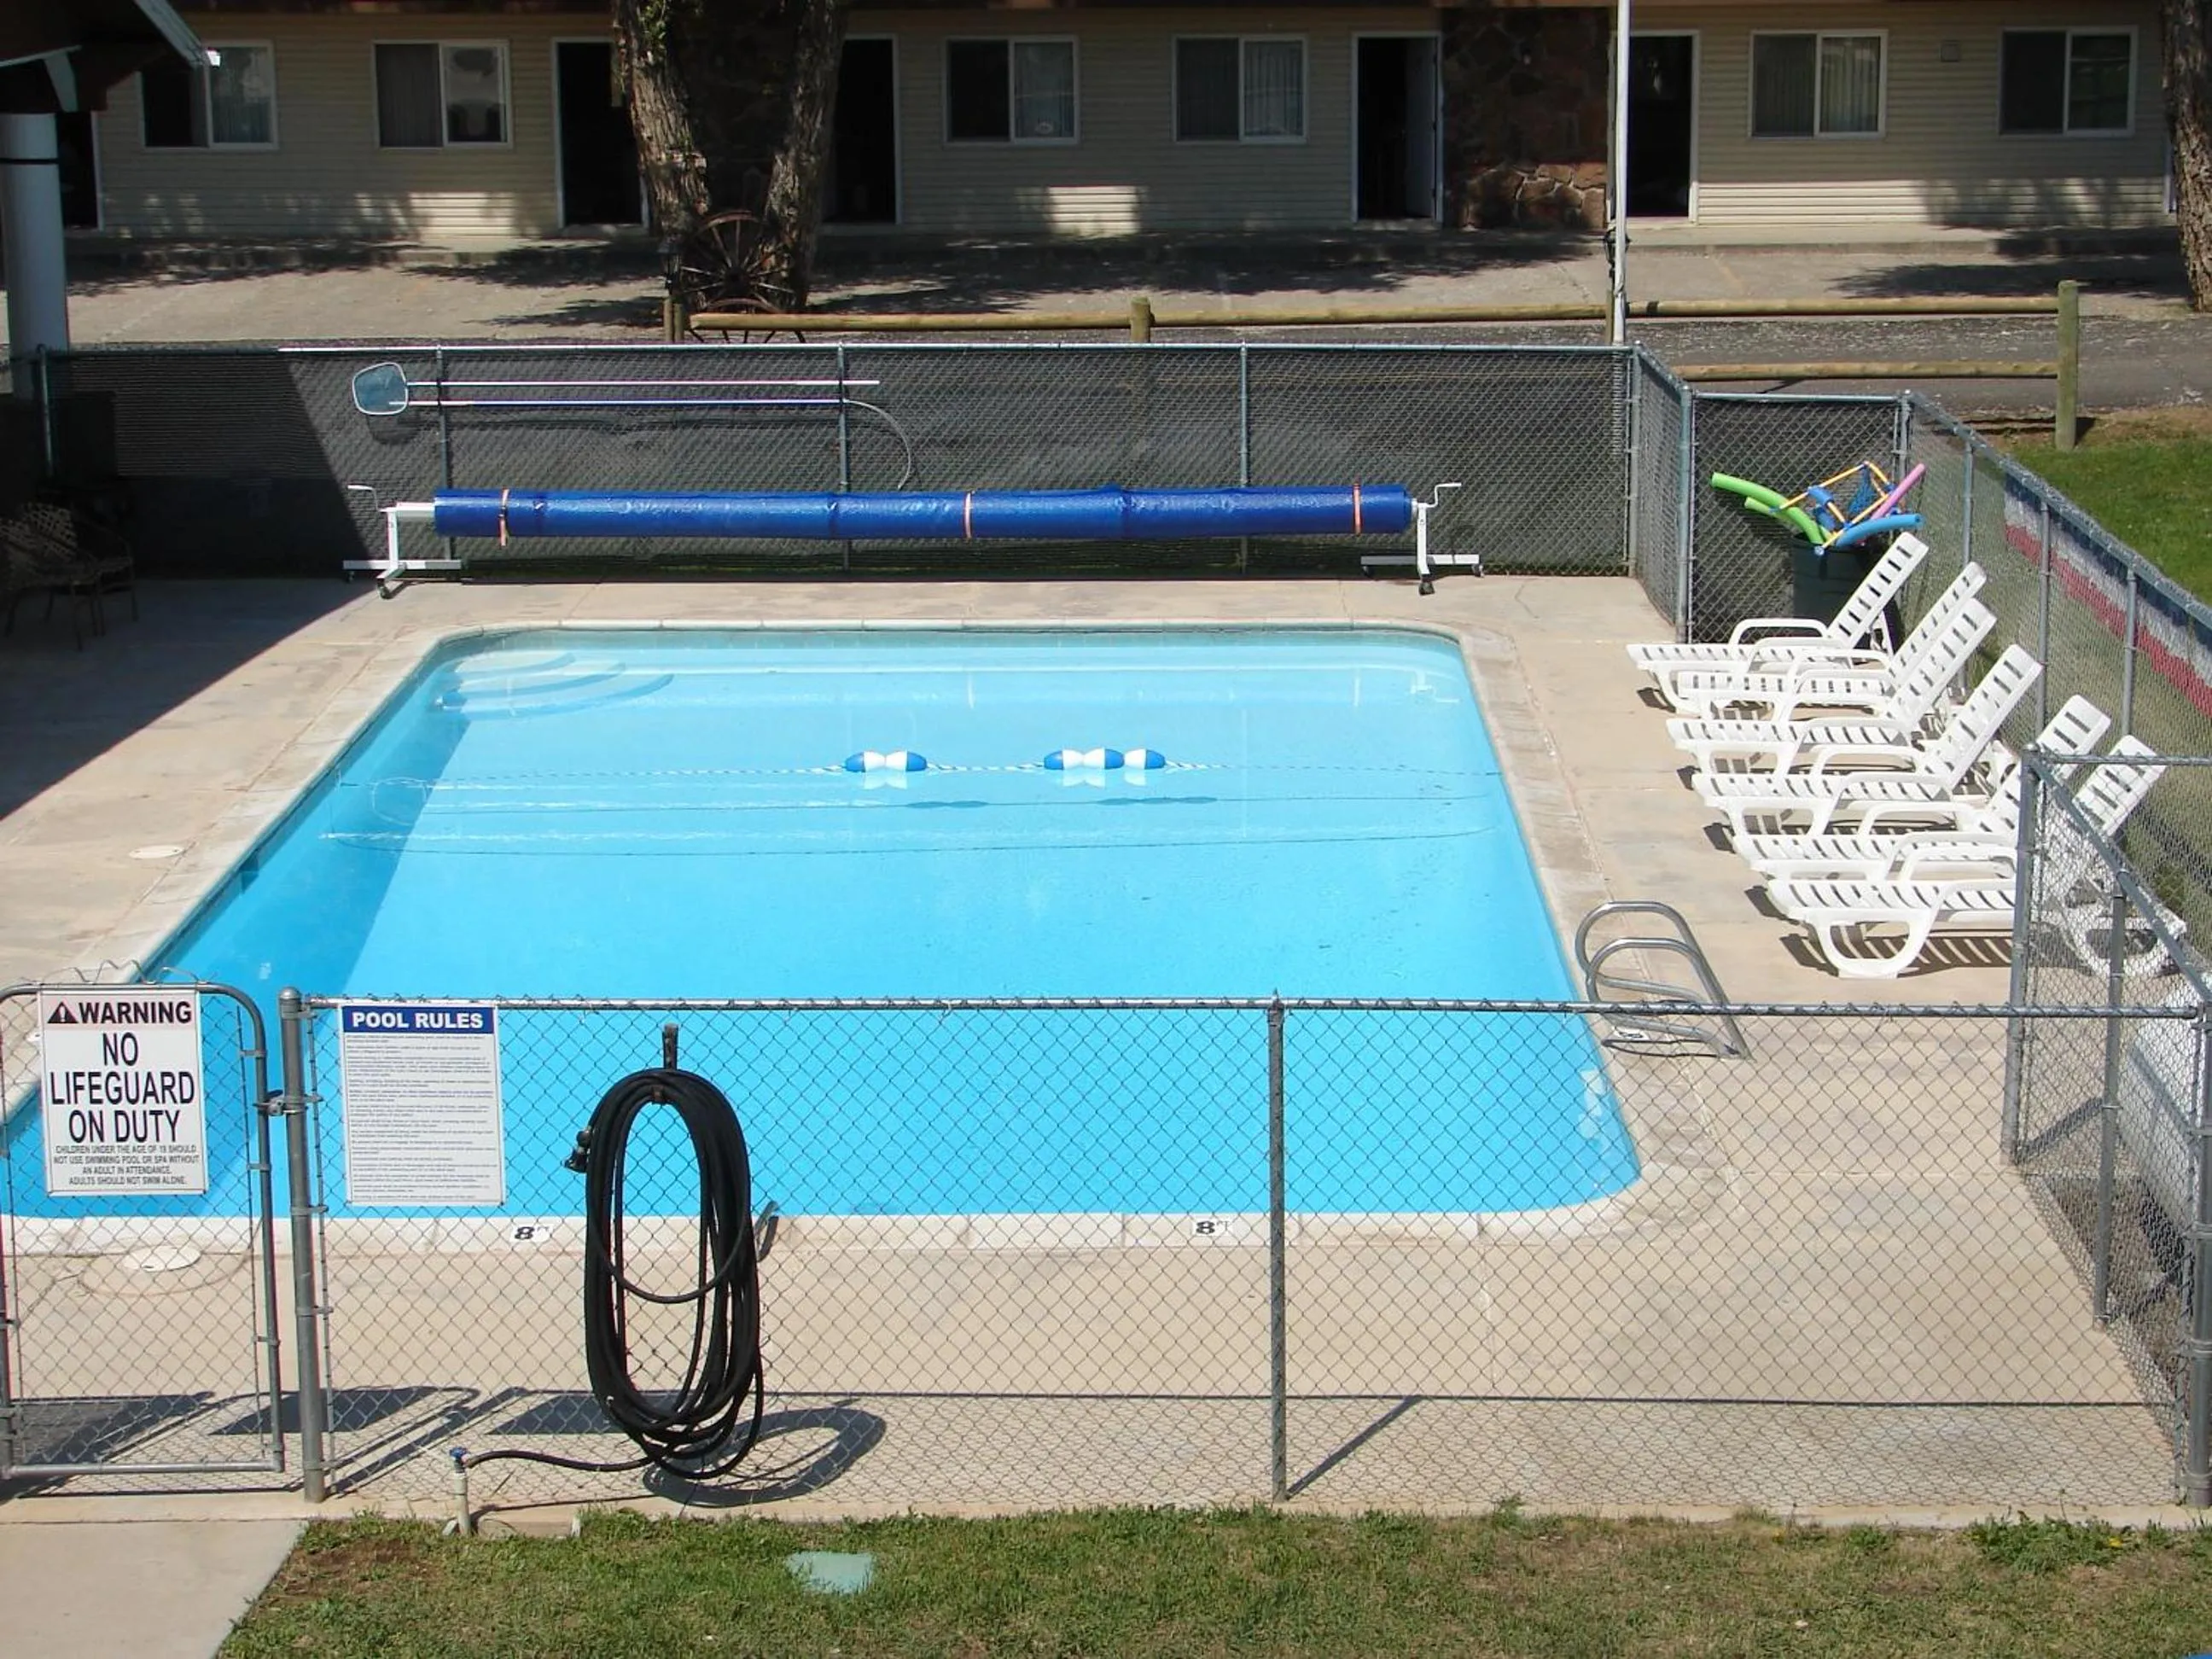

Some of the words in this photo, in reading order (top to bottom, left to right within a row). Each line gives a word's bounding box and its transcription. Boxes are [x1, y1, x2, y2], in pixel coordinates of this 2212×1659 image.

[79, 1001, 192, 1024] WARNING
[352, 1011, 410, 1028] POOL
[415, 1012, 483, 1029] RULES
[102, 1032, 139, 1067] NO
[49, 1071, 195, 1105] LIFEGUARD
[69, 1109, 104, 1144] ON
[114, 1109, 181, 1144] DUTY
[55, 1145, 90, 1154] CHILDREN
[91, 1145, 116, 1154] UNDER
[117, 1144, 130, 1154] THE
[131, 1144, 147, 1154] AGE
[148, 1144, 157, 1154] OF
[168, 1144, 196, 1154] SHOULD
[54, 1155, 68, 1164] NOT
[69, 1155, 84, 1164] USE
[84, 1155, 120, 1164] SWIMMING
[122, 1155, 141, 1164] POOL
[143, 1155, 152, 1164] OR
[154, 1155, 167, 1164] SPA
[168, 1155, 200, 1163] WITHOUT
[83, 1166, 92, 1174] AN
[94, 1166, 116, 1174] ADULT
[117, 1166, 125, 1174] IN
[69, 1177, 96, 1185] ADULTS
[97, 1177, 125, 1185] SHOULD
[126, 1177, 141, 1185] NOT
[143, 1177, 160, 1185] SWIM
